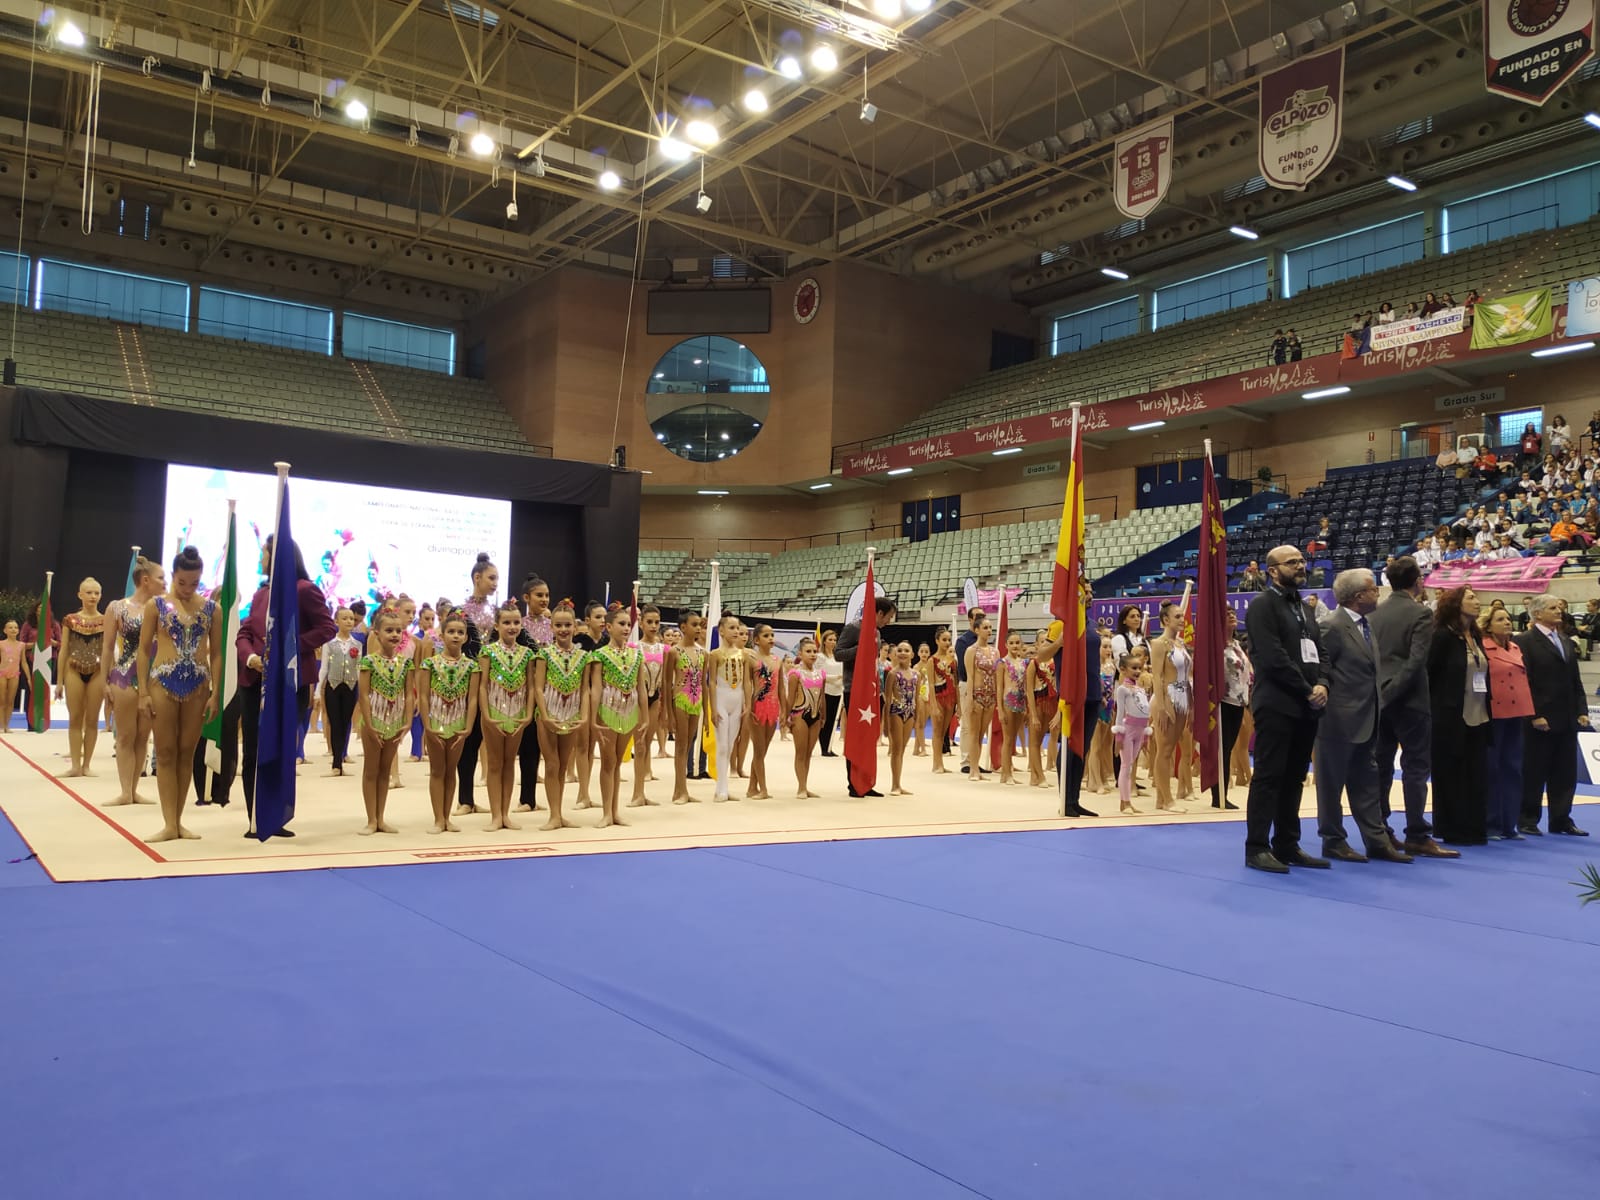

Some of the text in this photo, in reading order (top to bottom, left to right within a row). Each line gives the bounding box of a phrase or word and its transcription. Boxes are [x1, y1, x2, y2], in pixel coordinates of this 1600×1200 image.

[1499, 39, 1583, 76] FUNDADO EN
[1521, 61, 1560, 83] 1985
[1137, 152, 1151, 169] 13
[1282, 163, 1294, 174] EN
[1415, 314, 1461, 331] PACHECO
[1443, 392, 1497, 407] Grada Sur
